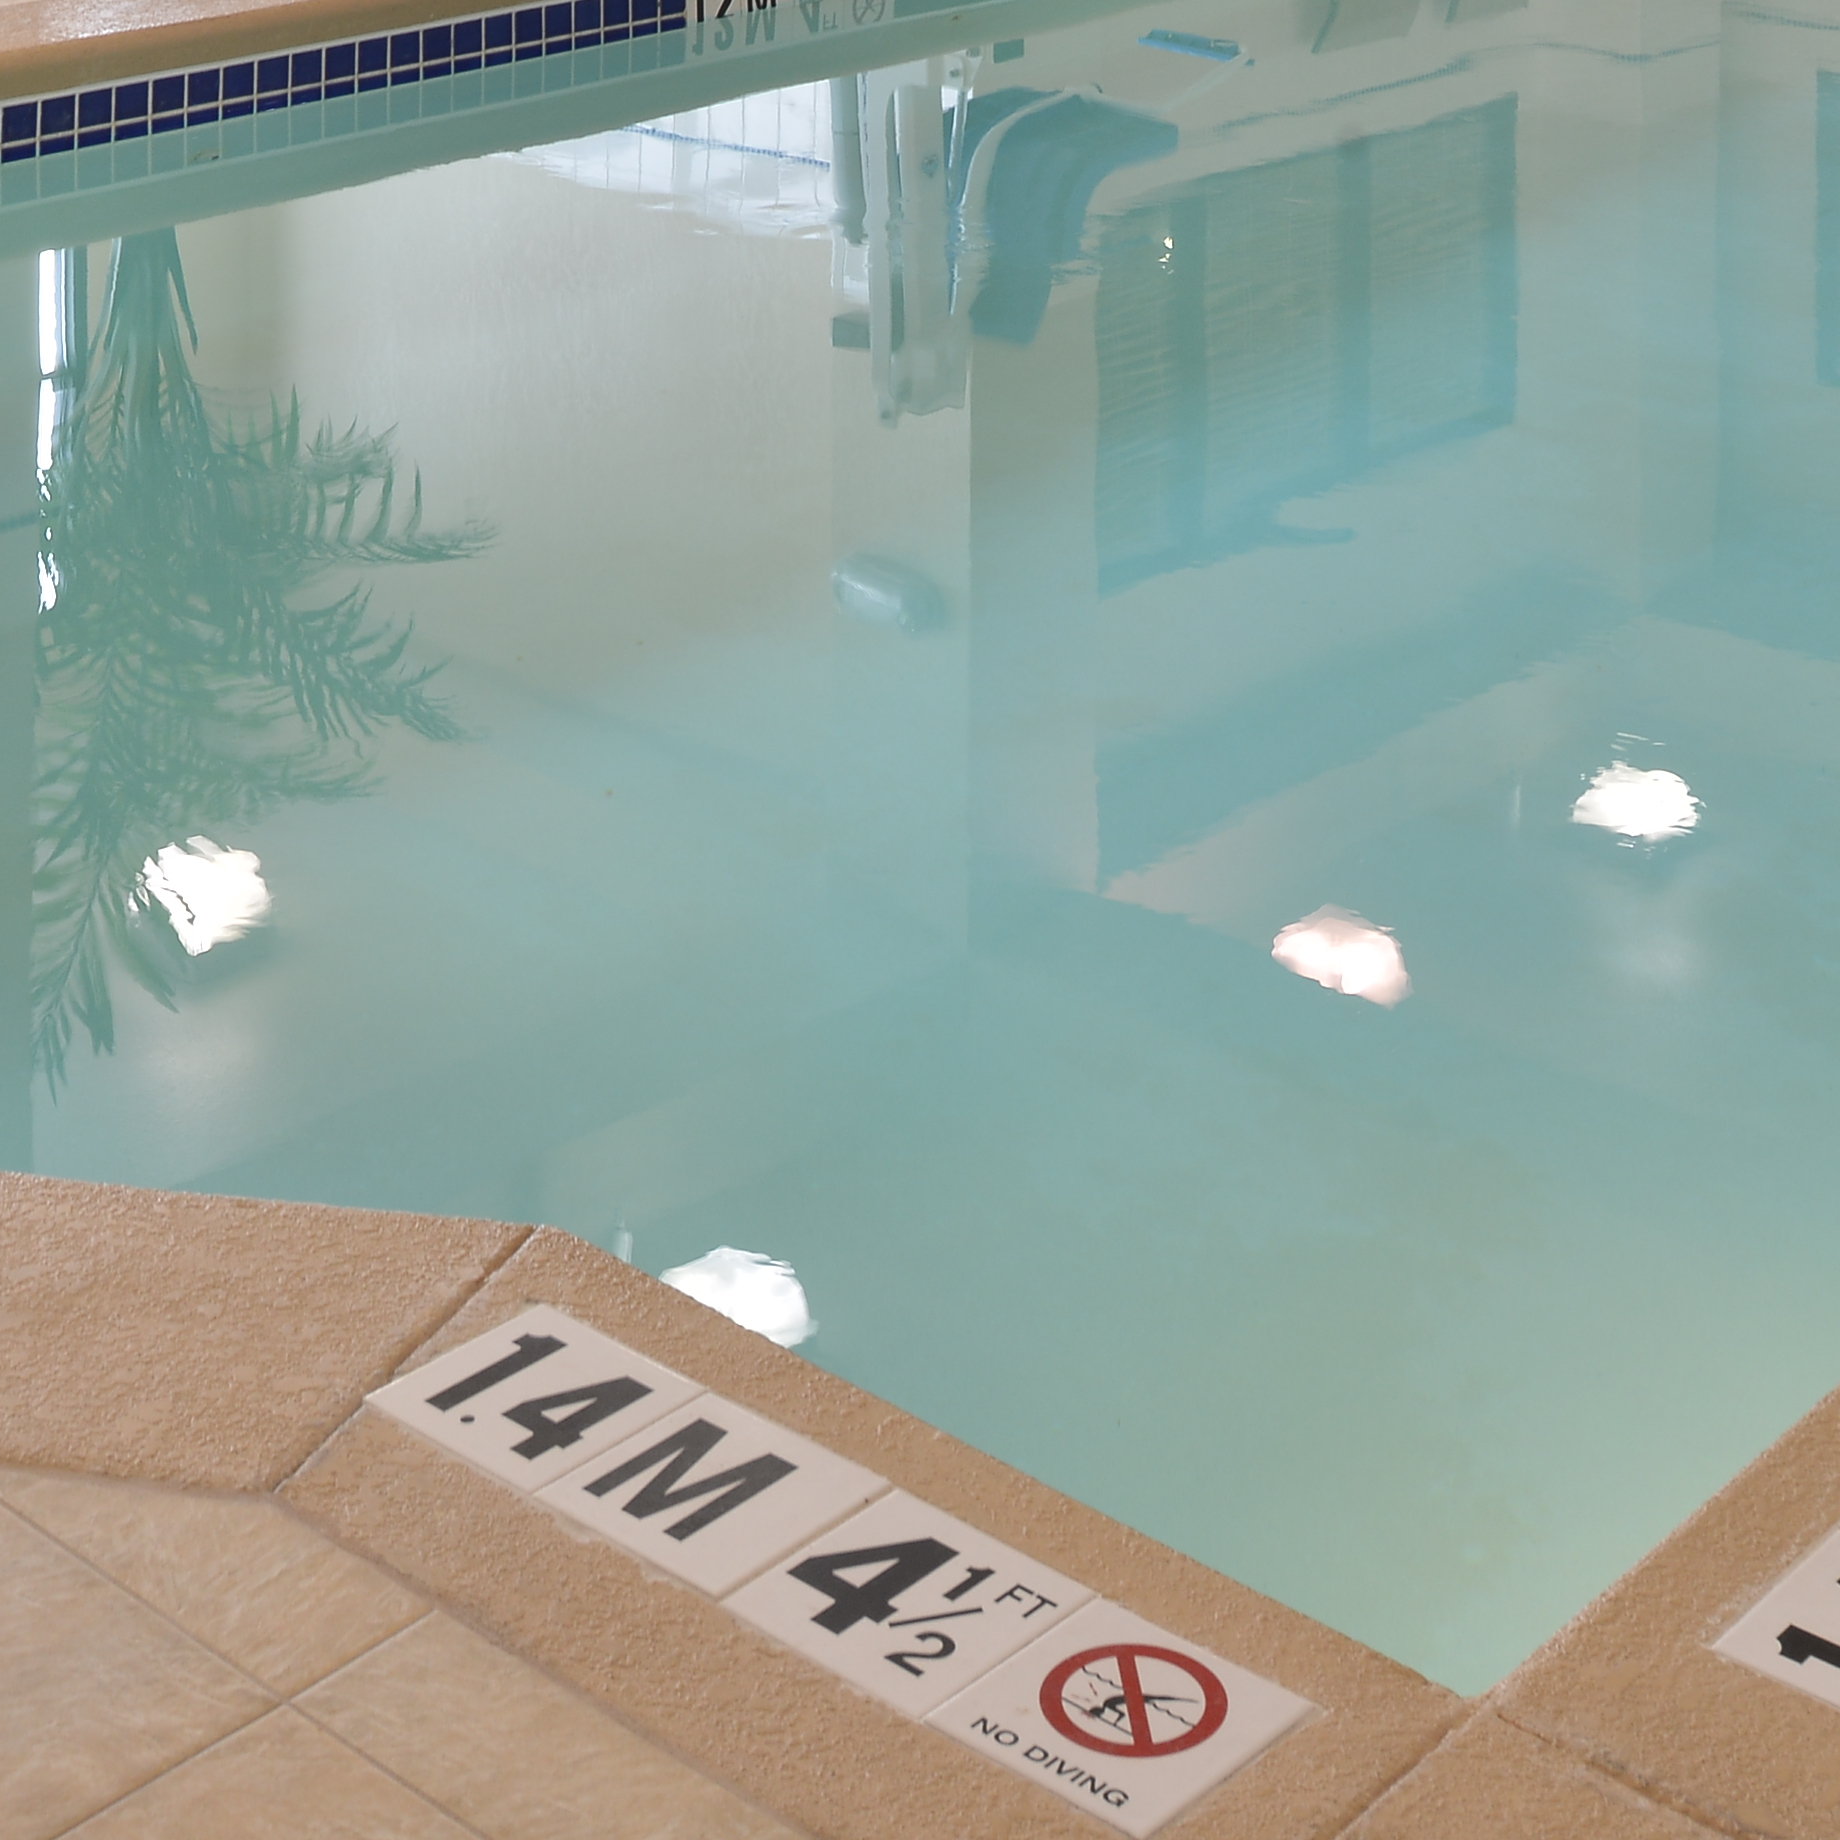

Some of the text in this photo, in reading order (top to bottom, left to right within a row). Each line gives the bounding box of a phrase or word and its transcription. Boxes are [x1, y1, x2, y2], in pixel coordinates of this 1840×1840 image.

[994, 1581, 1059, 1621] FT
[971, 1716, 1129, 1807] NO DIVING
